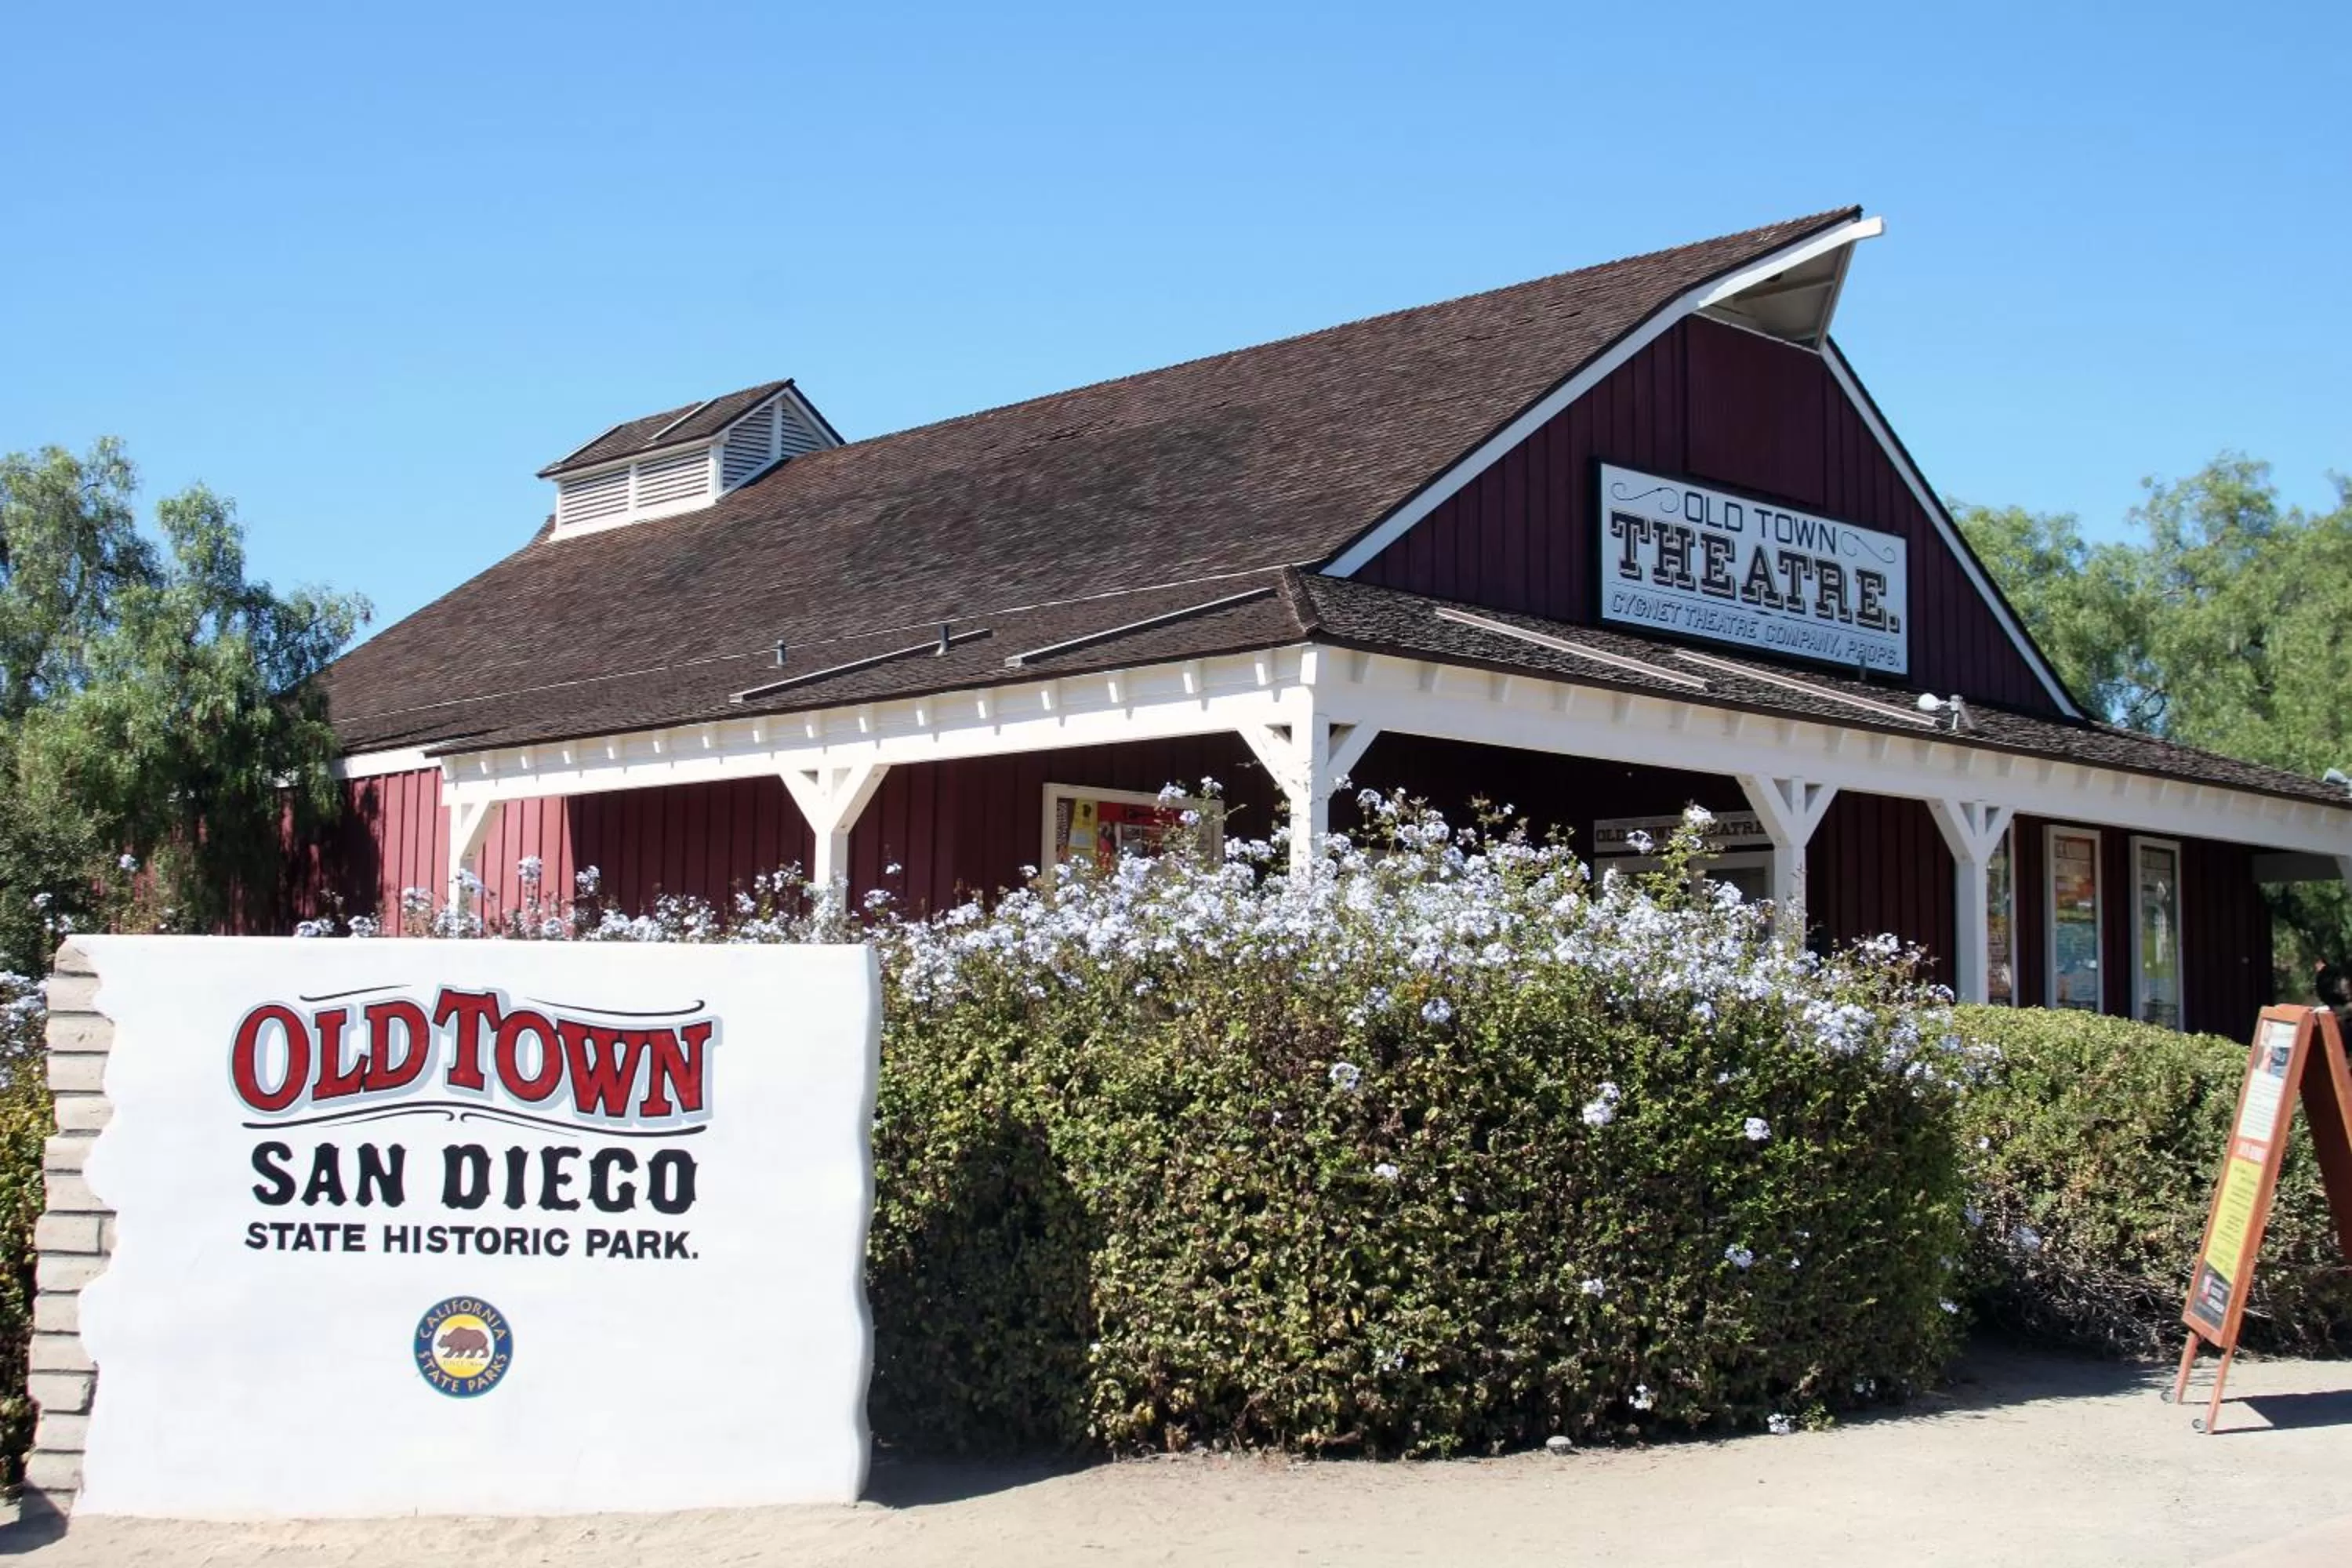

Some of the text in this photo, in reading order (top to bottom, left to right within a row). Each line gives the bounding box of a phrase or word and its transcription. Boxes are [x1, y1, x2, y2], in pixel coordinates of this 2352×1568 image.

[1685, 492, 1836, 554] OLD TOWN
[1610, 510, 1901, 633] THEATRE.
[1611, 592, 1681, 626] CYGNET
[1682, 604, 1757, 638] THEATRE
[1765, 625, 1842, 657] COMPANY,
[1596, 828, 1626, 843] OLD
[232, 988, 713, 1119] OLD TOWN
[251, 1141, 699, 1214] SAN DIEGO
[245, 1221, 699, 1260] STATE HISTORIC PARK.
[419, 1299, 506, 1341] CALIFORNIA
[418, 1350, 508, 1393] STATE PARKS
